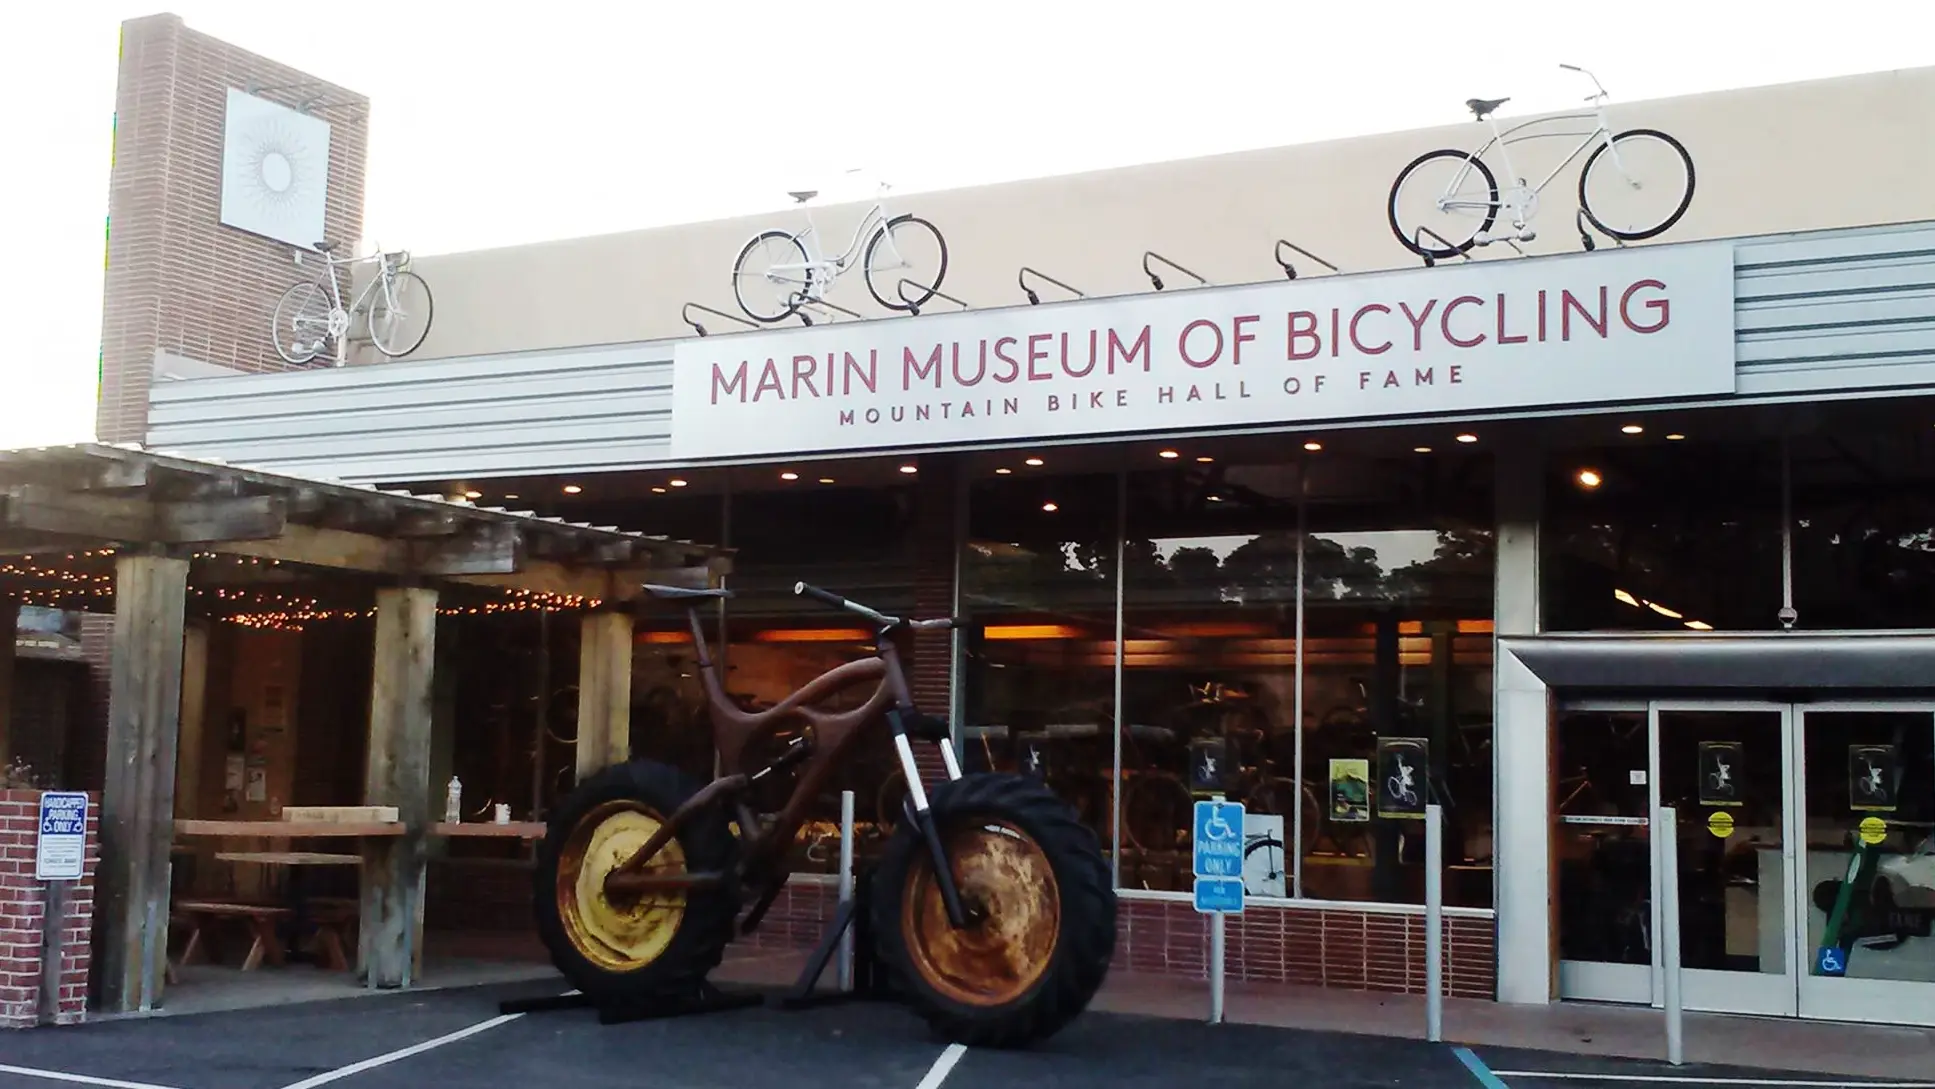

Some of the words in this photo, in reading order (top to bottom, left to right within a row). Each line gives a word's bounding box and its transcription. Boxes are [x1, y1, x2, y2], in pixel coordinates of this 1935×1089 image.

[711, 349, 876, 405] MARIN
[902, 324, 1151, 391] MUSEUM
[1178, 314, 1261, 369] OF
[1287, 278, 1670, 361] BICYCLING
[839, 397, 1018, 426] MOUNTAIN
[1048, 389, 1127, 412] BIKE
[1158, 380, 1251, 404] HALL
[1283, 375, 1326, 395] OF
[1359, 364, 1463, 390] FAME
[54, 820, 73, 833] ONLY
[1205, 857, 1232, 874] ONLY
